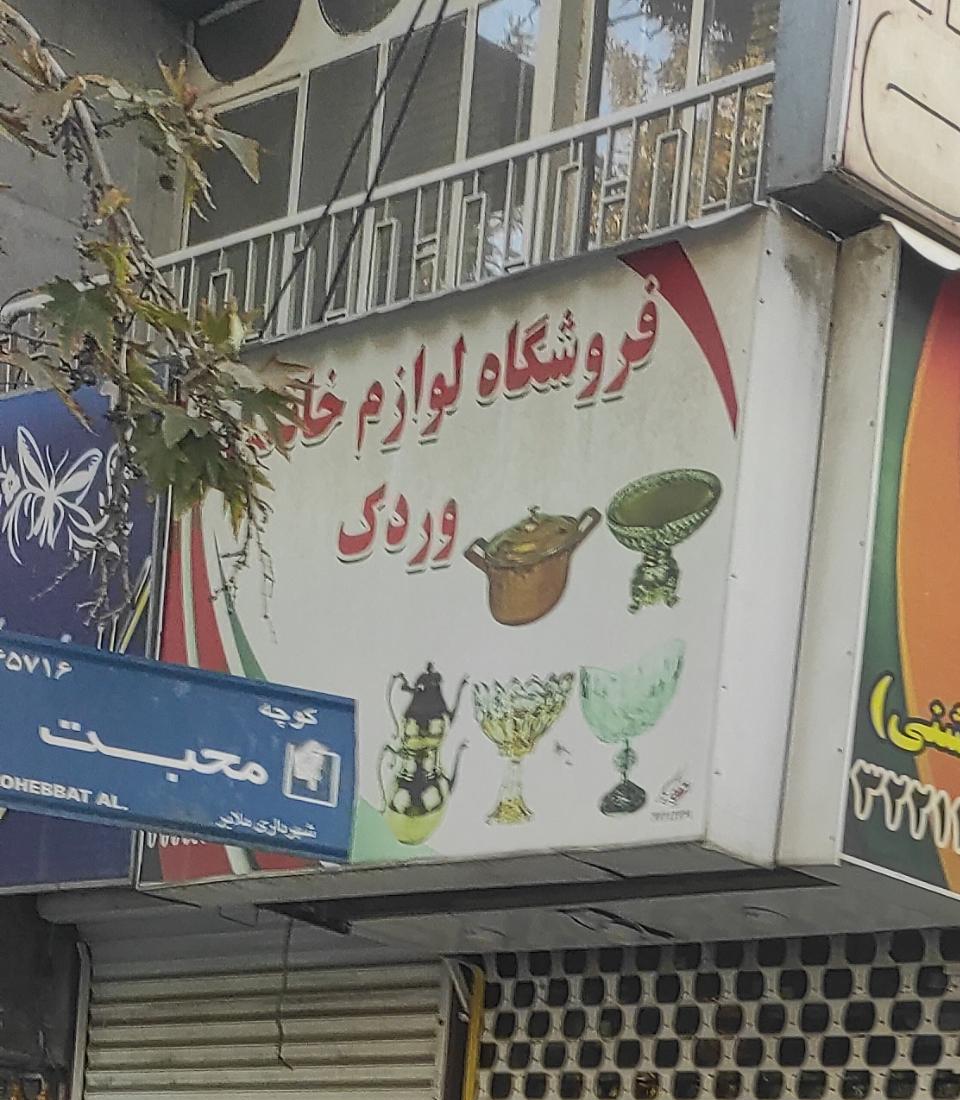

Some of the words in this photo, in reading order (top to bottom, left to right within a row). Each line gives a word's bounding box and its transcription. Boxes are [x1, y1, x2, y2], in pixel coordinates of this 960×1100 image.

[479, 274, 661, 404] فروشگاه
[356, 333, 467, 455] لوازم
[258, 703, 319, 730] کوچه
[38, 718, 269, 785] محبت
[0, 774, 93, 804] OHEBBAT
[251, 818, 317, 840] شهرداری
